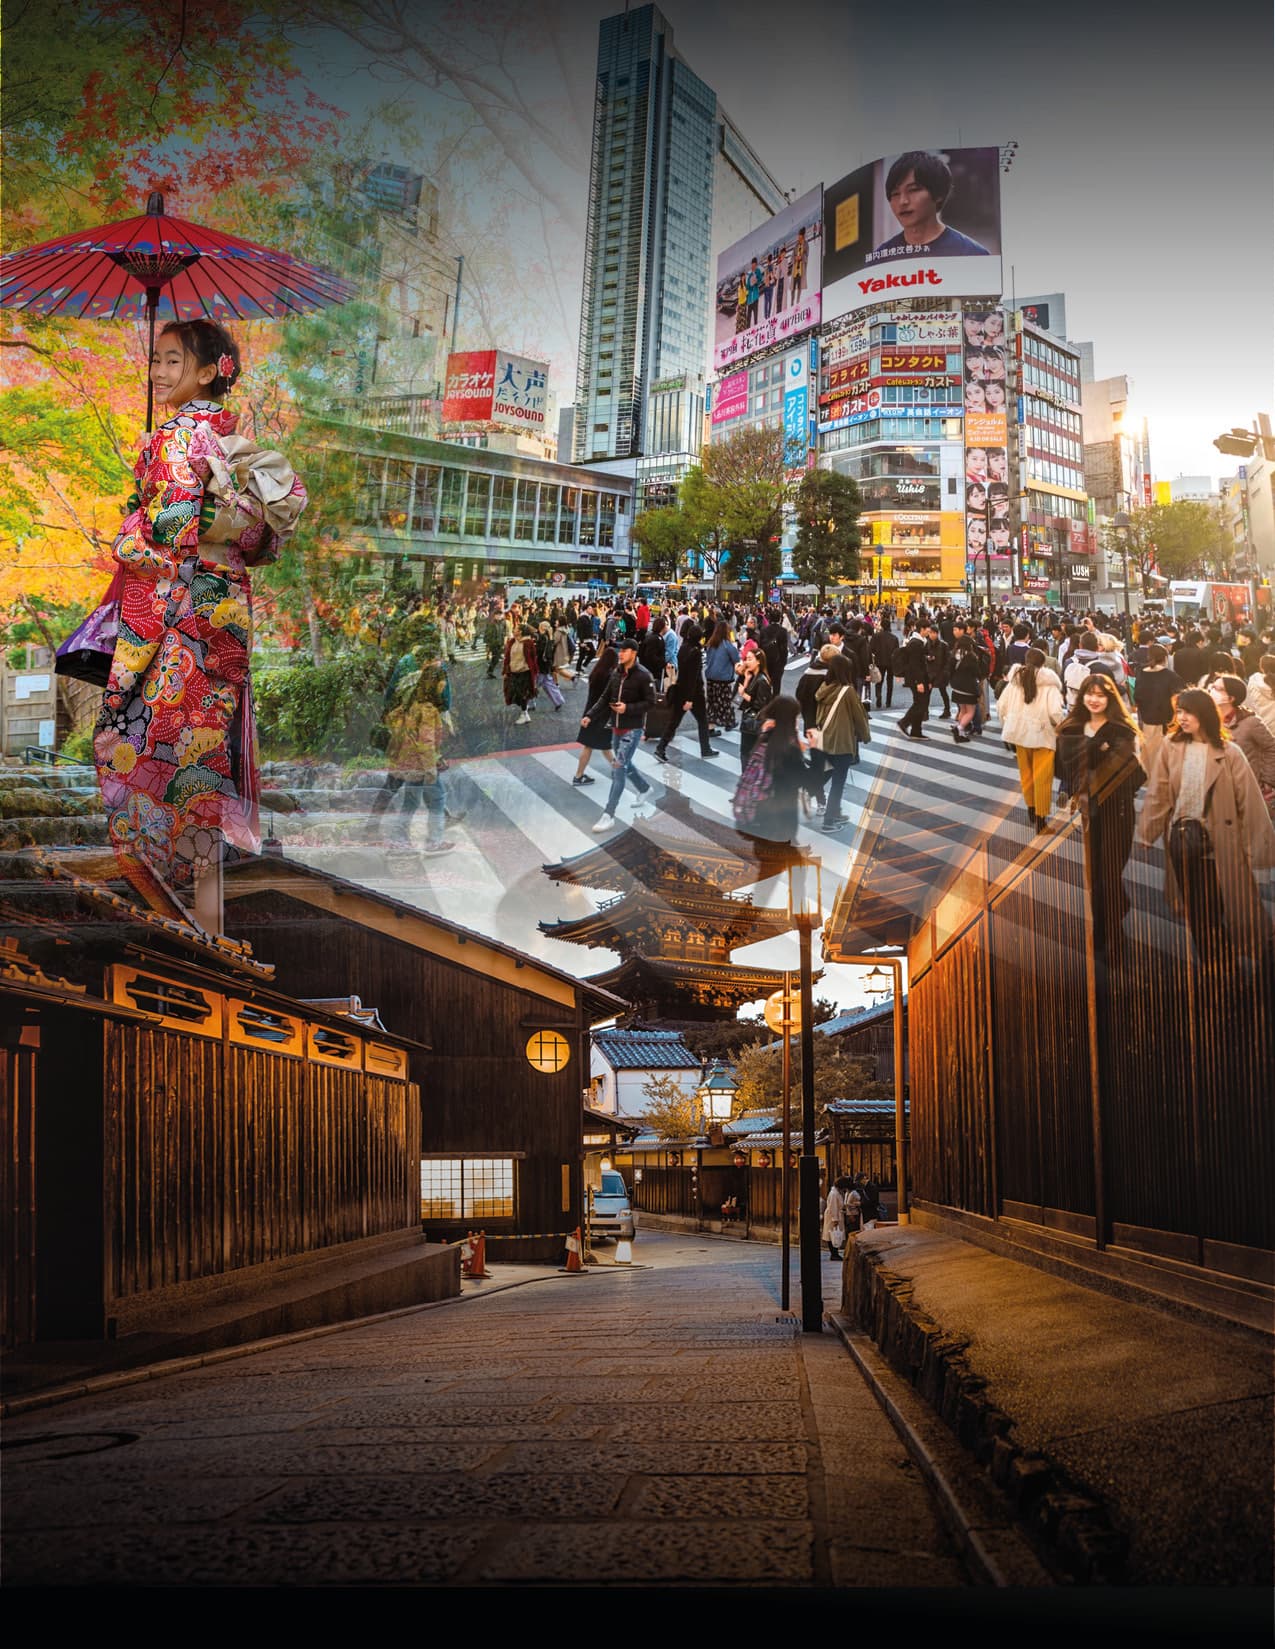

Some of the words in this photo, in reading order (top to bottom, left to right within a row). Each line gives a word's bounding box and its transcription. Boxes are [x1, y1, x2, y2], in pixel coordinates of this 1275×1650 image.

[858, 269, 942, 294] Yakult
[881, 356, 944, 368] コンタクト
[448, 372, 493, 388] カラオケ
[851, 380, 871, 396] ガスト
[924, 376, 954, 388] ガスト
[494, 402, 544, 423] JOYSOUND
[841, 399, 866, 417] ガスト
[1072, 565, 1090, 577] LUSH
